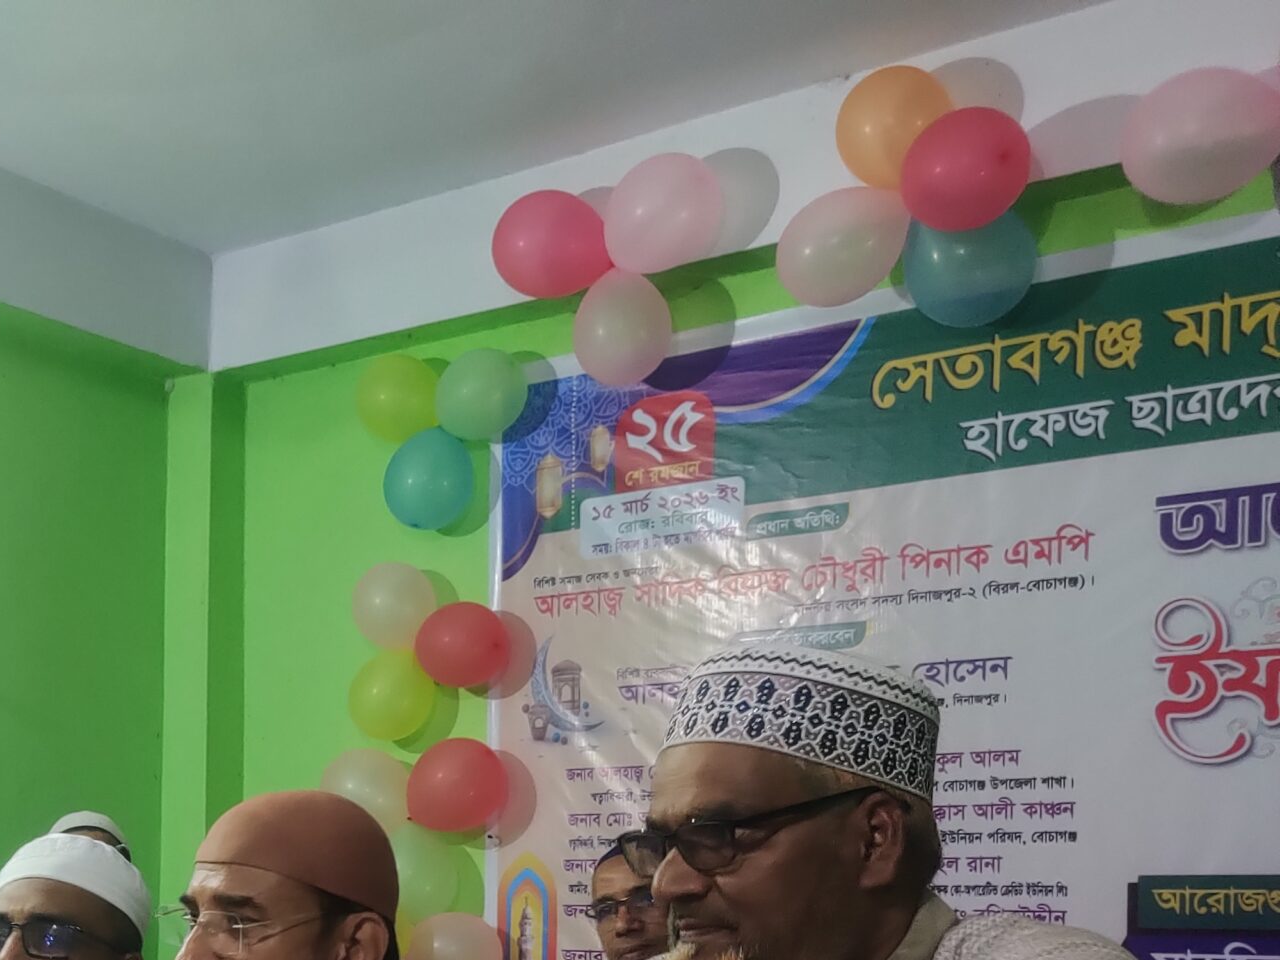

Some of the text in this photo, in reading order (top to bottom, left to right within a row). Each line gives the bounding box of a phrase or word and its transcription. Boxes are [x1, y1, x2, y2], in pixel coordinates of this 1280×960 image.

[871, 318, 1143, 409] সেতাবগঞ্জ
[626, 401, 705, 463] ২৫
[960, 370, 1280, 462] হাফেজ ছাত্রদে
[592, 504, 615, 521] ১৫
[622, 491, 651, 516] মার্চ
[657, 492, 709, 512] ২০২৬
[533, 586, 625, 618] আলহাজ্ব
[801, 546, 890, 594] চৌধুরী
[897, 543, 993, 581] পিনাক
[1004, 523, 1096, 568] এমপি
[565, 768, 595, 782] জনাব
[969, 749, 1022, 768] আলম
[568, 813, 601, 828] জনাব
[972, 797, 1016, 820] আলী
[966, 855, 1003, 873] রানা
